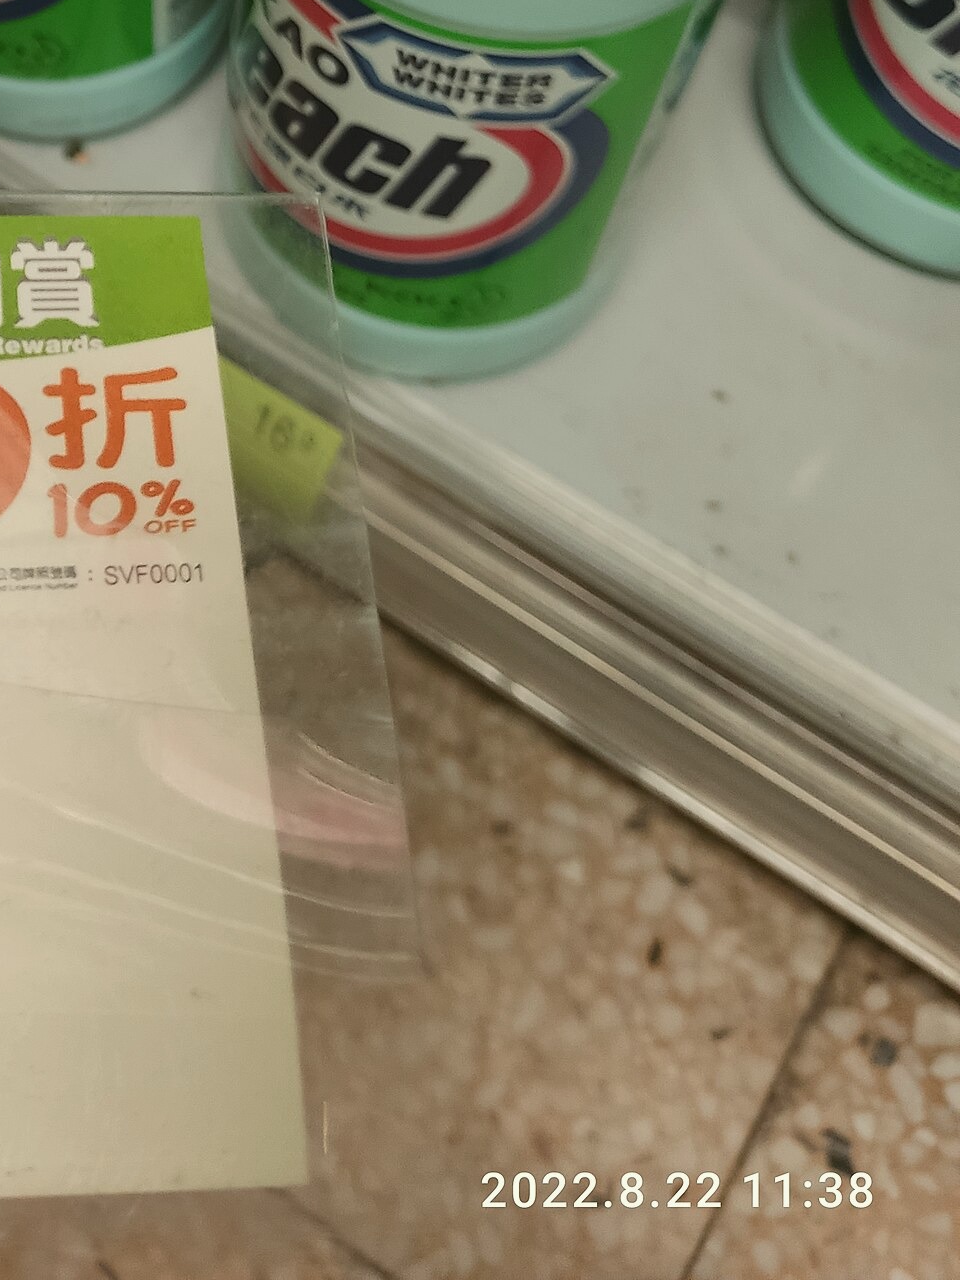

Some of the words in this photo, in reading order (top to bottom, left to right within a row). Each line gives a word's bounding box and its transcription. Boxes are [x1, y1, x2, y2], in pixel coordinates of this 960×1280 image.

[392, 66, 545, 106] WHITES
[396, 48, 552, 88] WHITER
[46, 479, 196, 538] 10%
[143, 519, 198, 535] OFF
[104, 562, 205, 587] SVF0001
